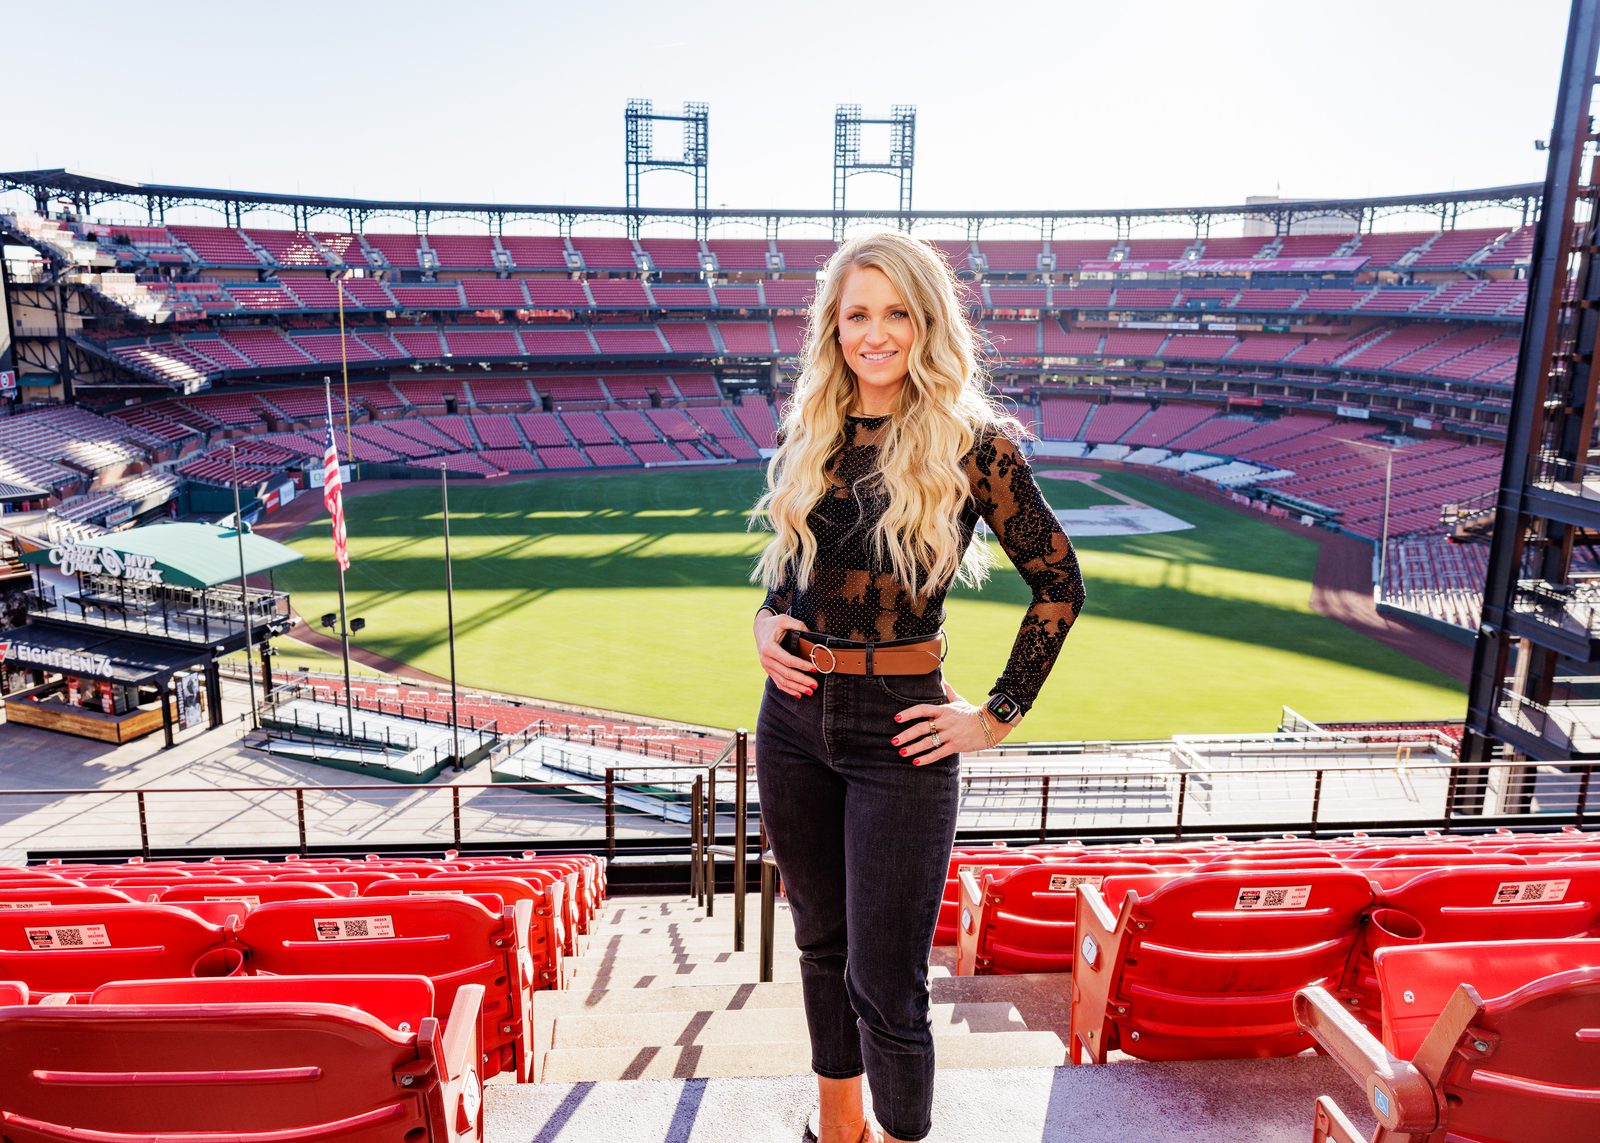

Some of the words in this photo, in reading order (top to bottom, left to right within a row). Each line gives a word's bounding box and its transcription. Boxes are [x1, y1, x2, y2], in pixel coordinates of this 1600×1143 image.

[48, 545, 96, 565] CREDIT
[123, 553, 154, 568] MVP
[60, 560, 102, 576] UNION
[123, 566, 164, 583] DECK
